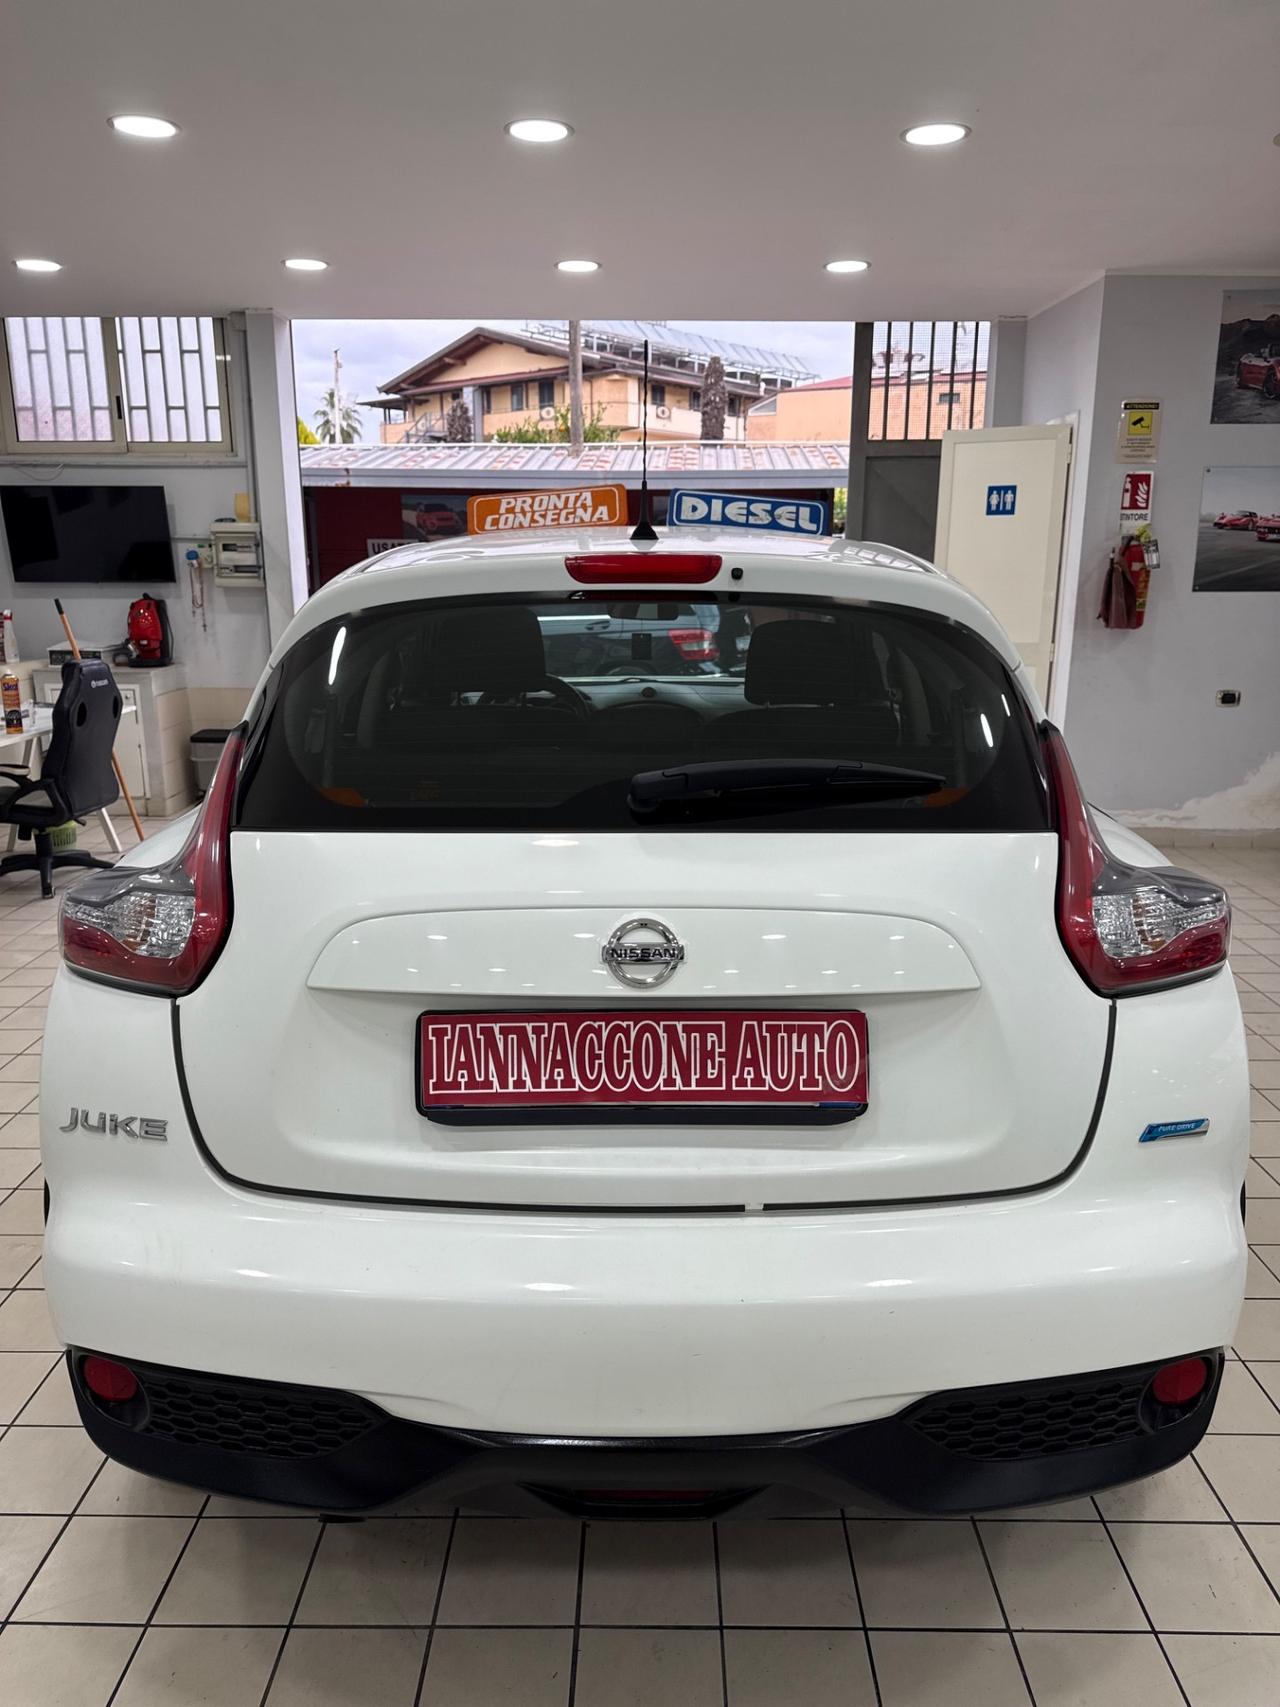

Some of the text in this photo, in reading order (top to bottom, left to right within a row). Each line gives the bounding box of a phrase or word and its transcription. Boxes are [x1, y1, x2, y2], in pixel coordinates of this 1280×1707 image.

[499, 491, 593, 514] PRONTA
[680, 496, 817, 531] DIESEL
[484, 505, 610, 531] CONSEGNA
[610, 948, 676, 959] NISSAN
[428, 1019, 861, 1095] IANNACCONE AUTO
[59, 1107, 168, 1142] JUKE
